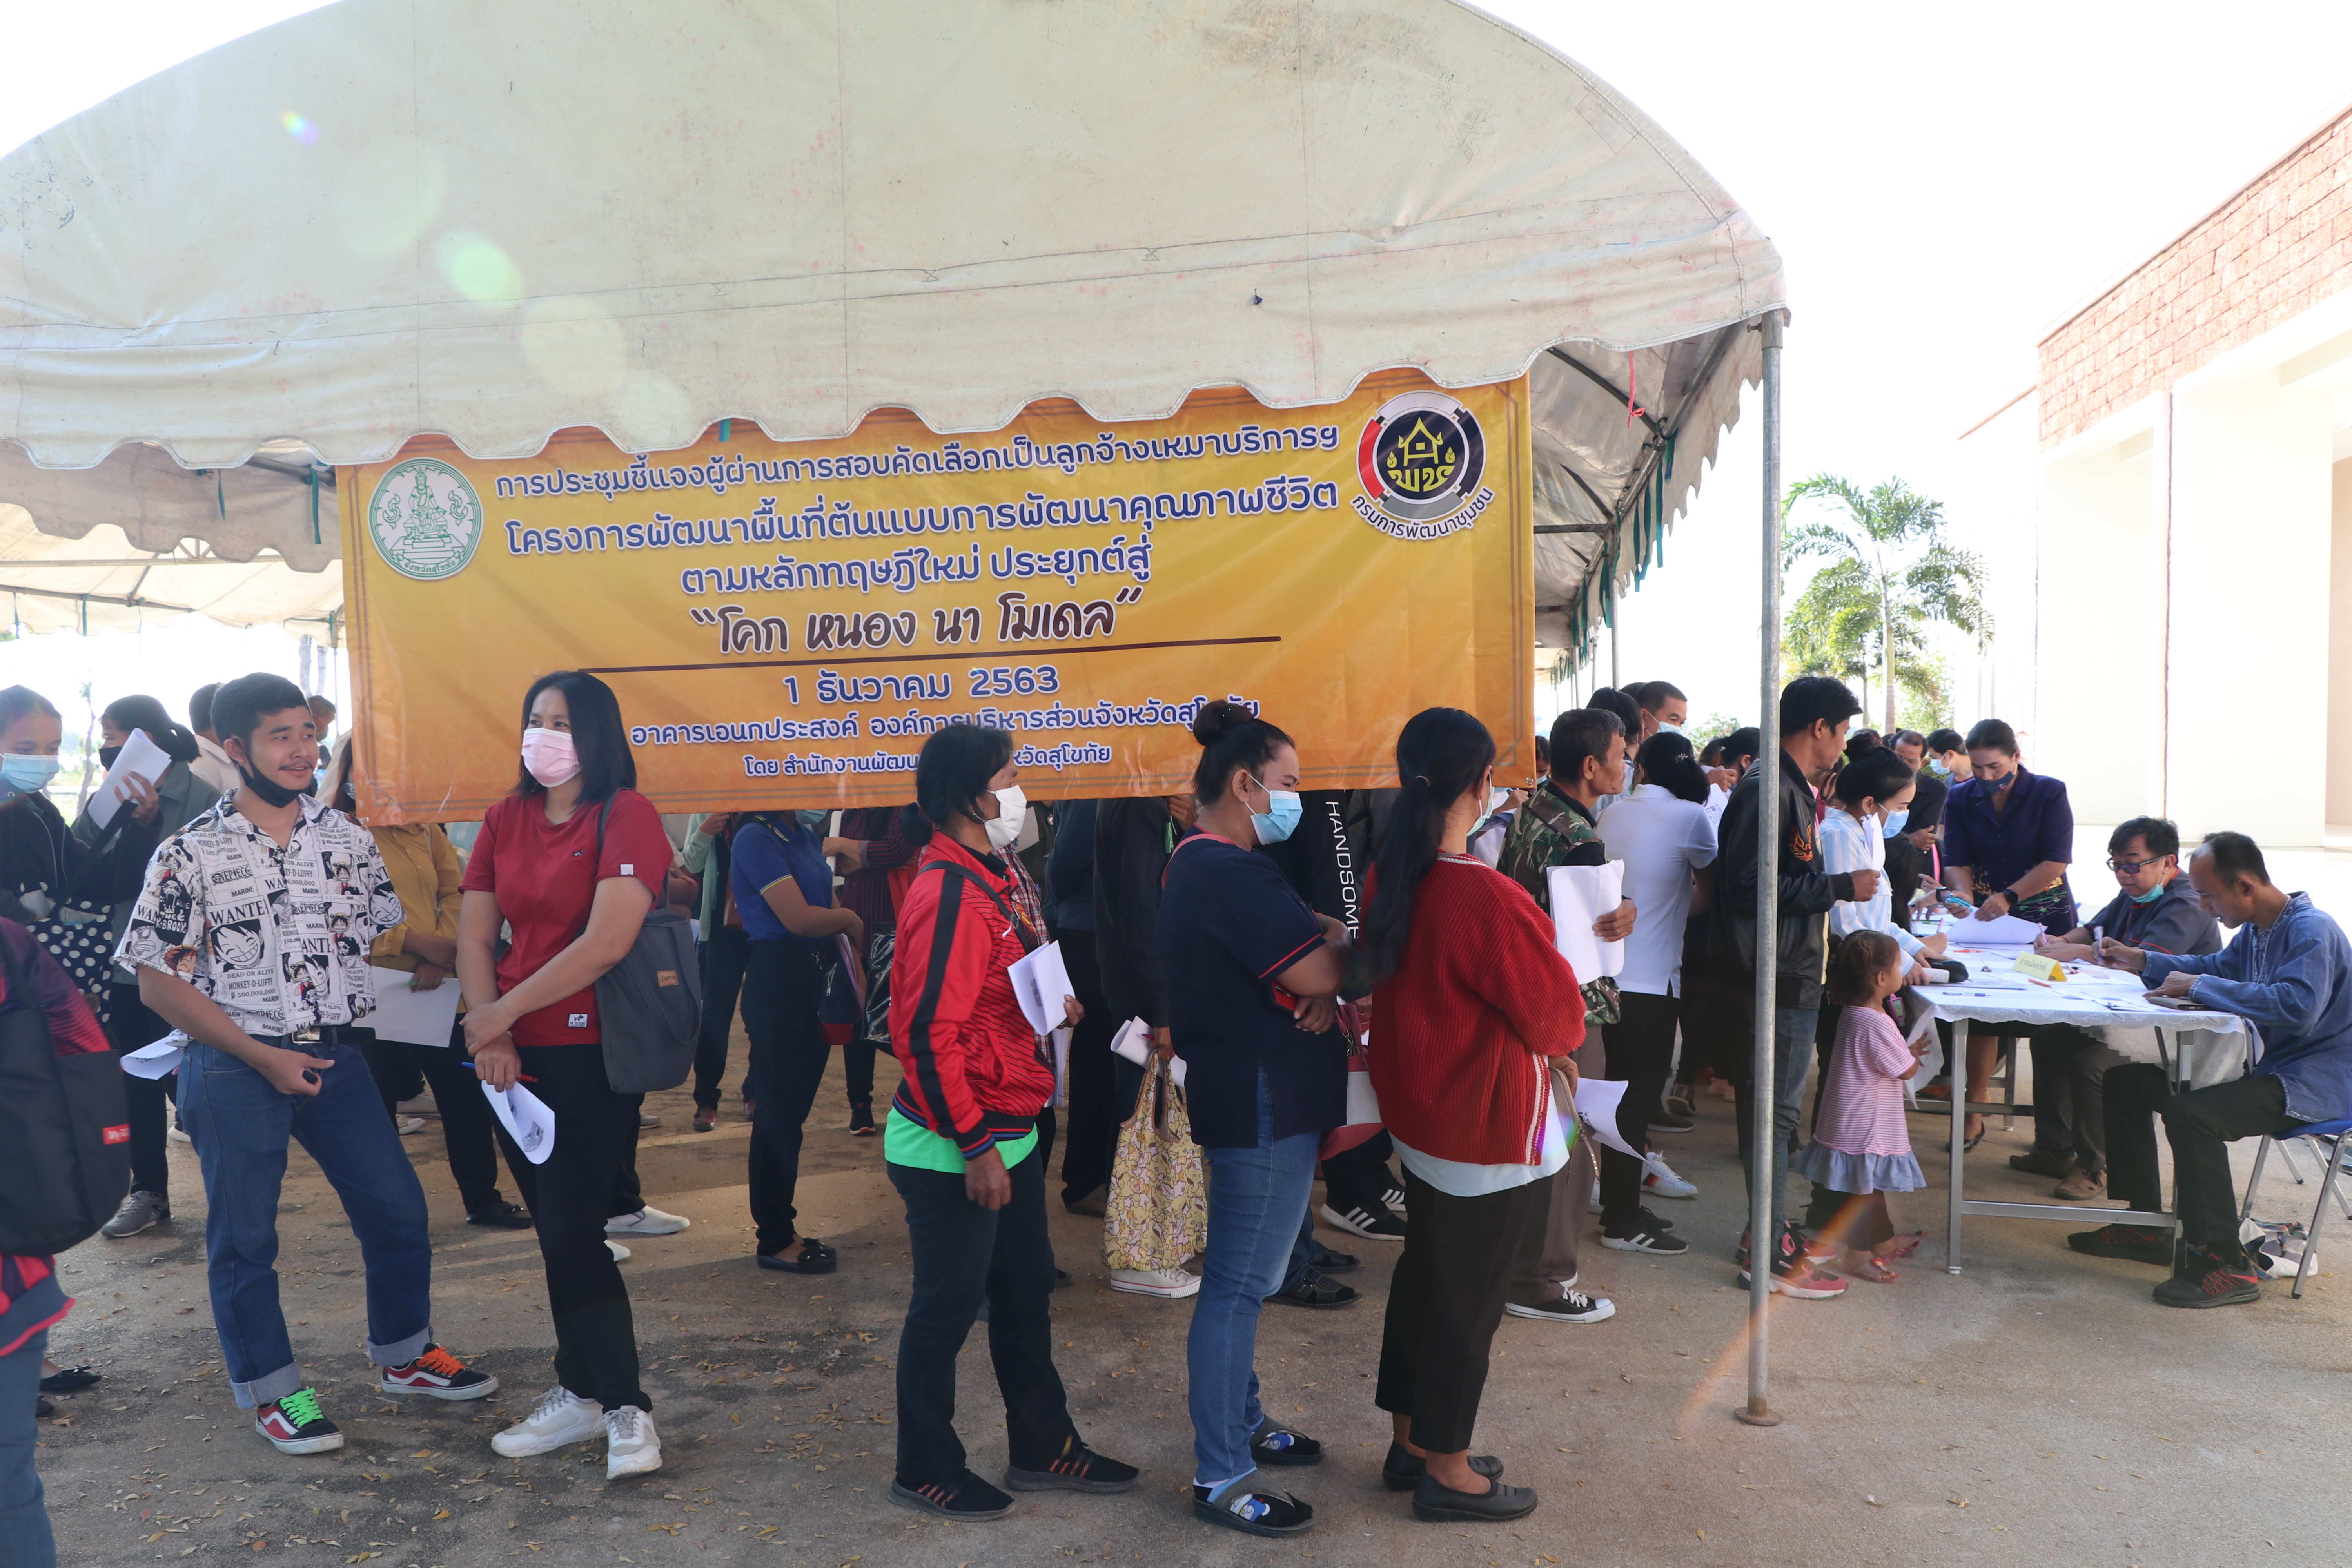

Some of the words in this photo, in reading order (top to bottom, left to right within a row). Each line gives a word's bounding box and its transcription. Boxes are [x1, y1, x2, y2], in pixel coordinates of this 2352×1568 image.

[497, 426, 1338, 500] การประชุมชี้แจงผู้ผ่านการสอบคัดเลือกเป็นลูกจ้างเหมาบริการฯ
[505, 476, 1337, 553] โครงการพัฒนาพื้นที่ต้นแบบการพัฒนาคุณภาพชีวิต
[1352, 487, 1494, 539] กรมการพัฒนาชุมชน
[682, 544, 980, 592] ตามหลักทฤษฎีใหม่
[991, 534, 1151, 584] ประยุกต์สู่
[806, 611, 916, 649] หนอง
[933, 607, 981, 642] นา
[784, 676, 798, 703] 1
[817, 669, 951, 702] ธันวาคม
[969, 666, 1059, 696] 2563
[632, 713, 858, 745] อาคารเอนกประสงค์
[744, 756, 779, 775] โดย
[231, 886, 254, 897] MARINE
[228, 977, 273, 990] MONKEY-D-LUFFY
[238, 988, 276, 998] 500,000,000
[262, 1023, 285, 1034] MARINE
